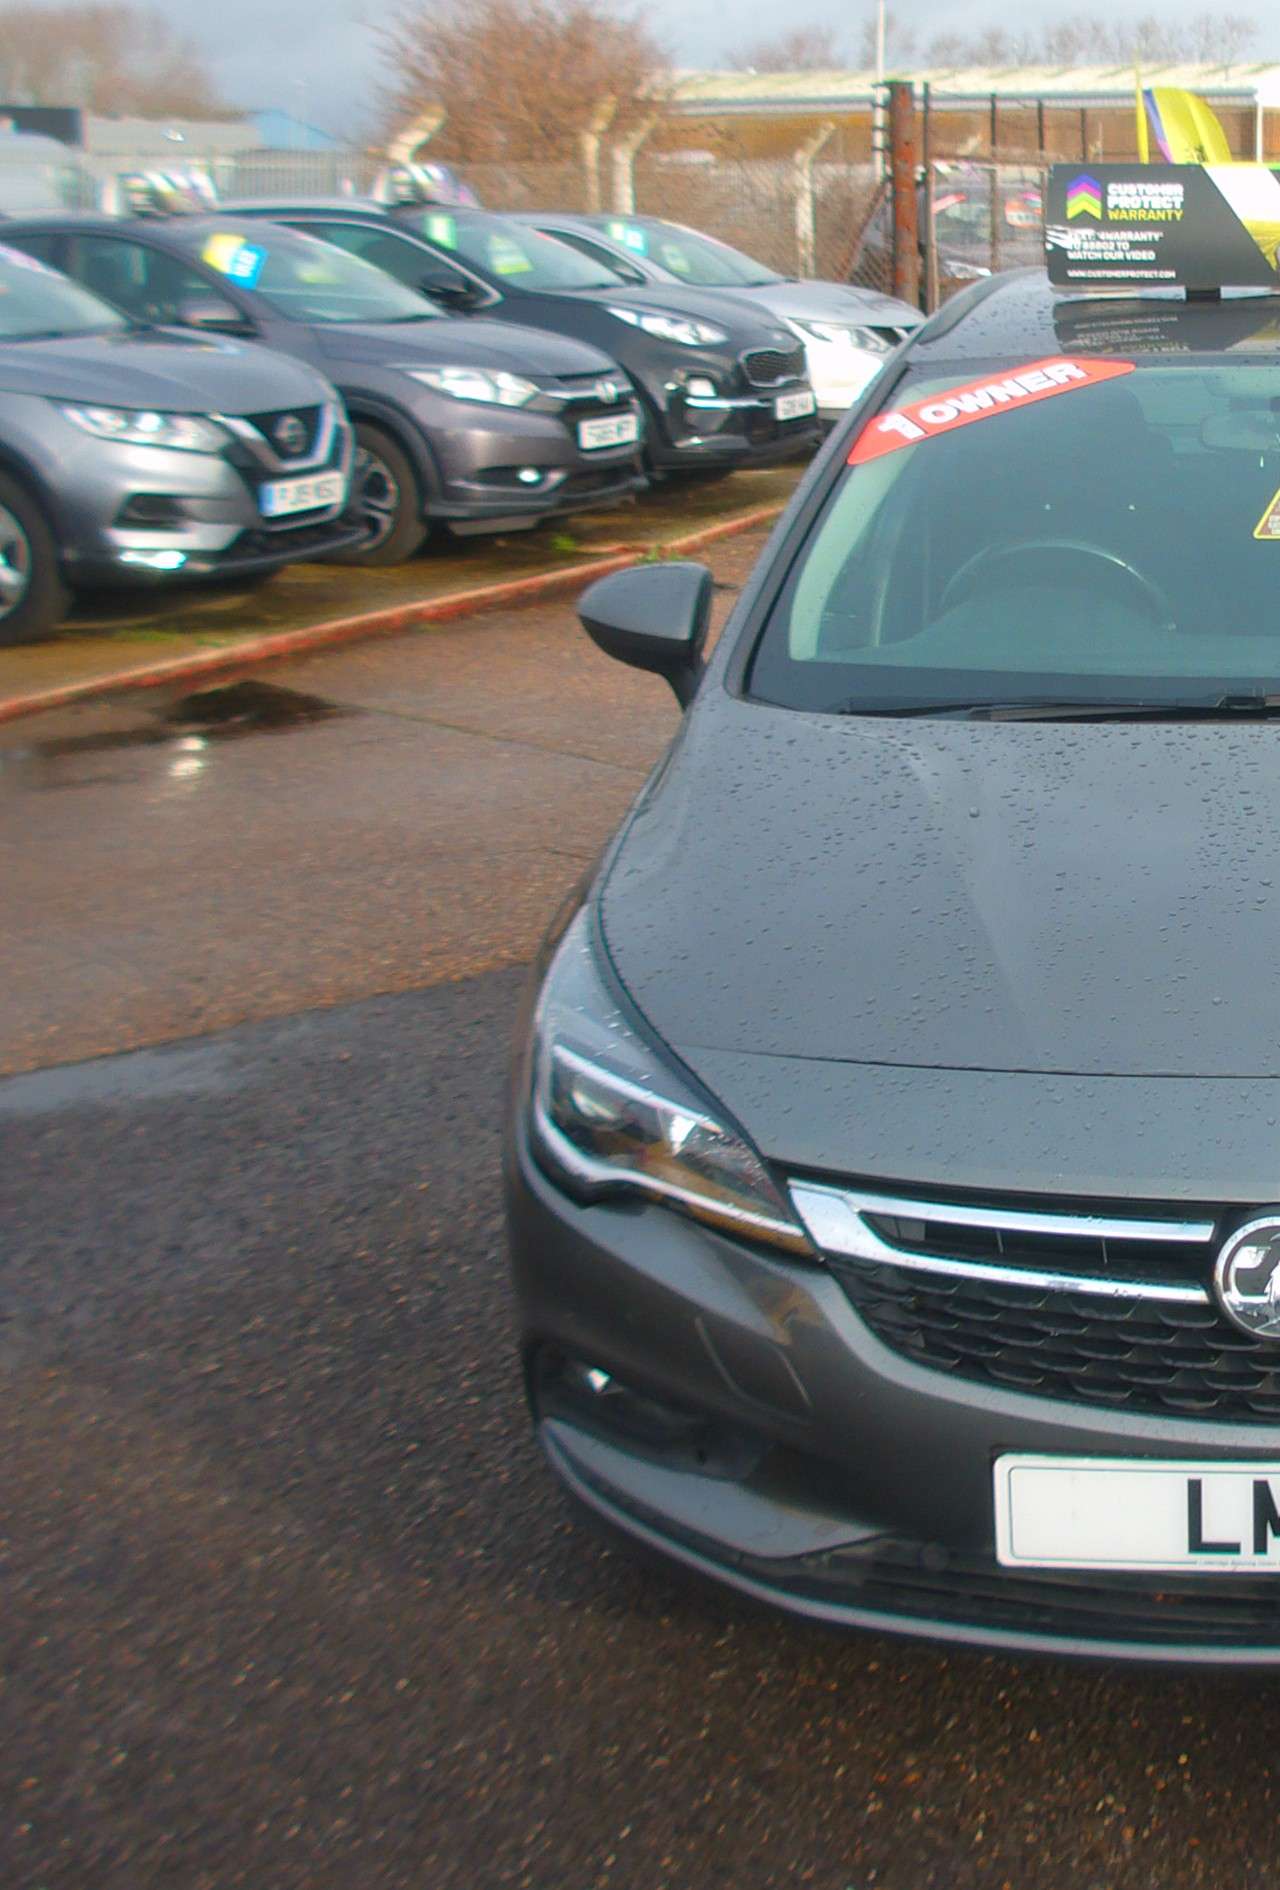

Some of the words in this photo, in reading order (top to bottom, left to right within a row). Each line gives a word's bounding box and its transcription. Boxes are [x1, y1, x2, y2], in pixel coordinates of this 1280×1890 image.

[1107, 183, 1184, 197] CUSTOMER
[1107, 196, 1184, 209] PROTECT
[1107, 209, 1184, 221] WARRANTY
[877, 412, 926, 440] 1
[919, 362, 1088, 424] OWNER
